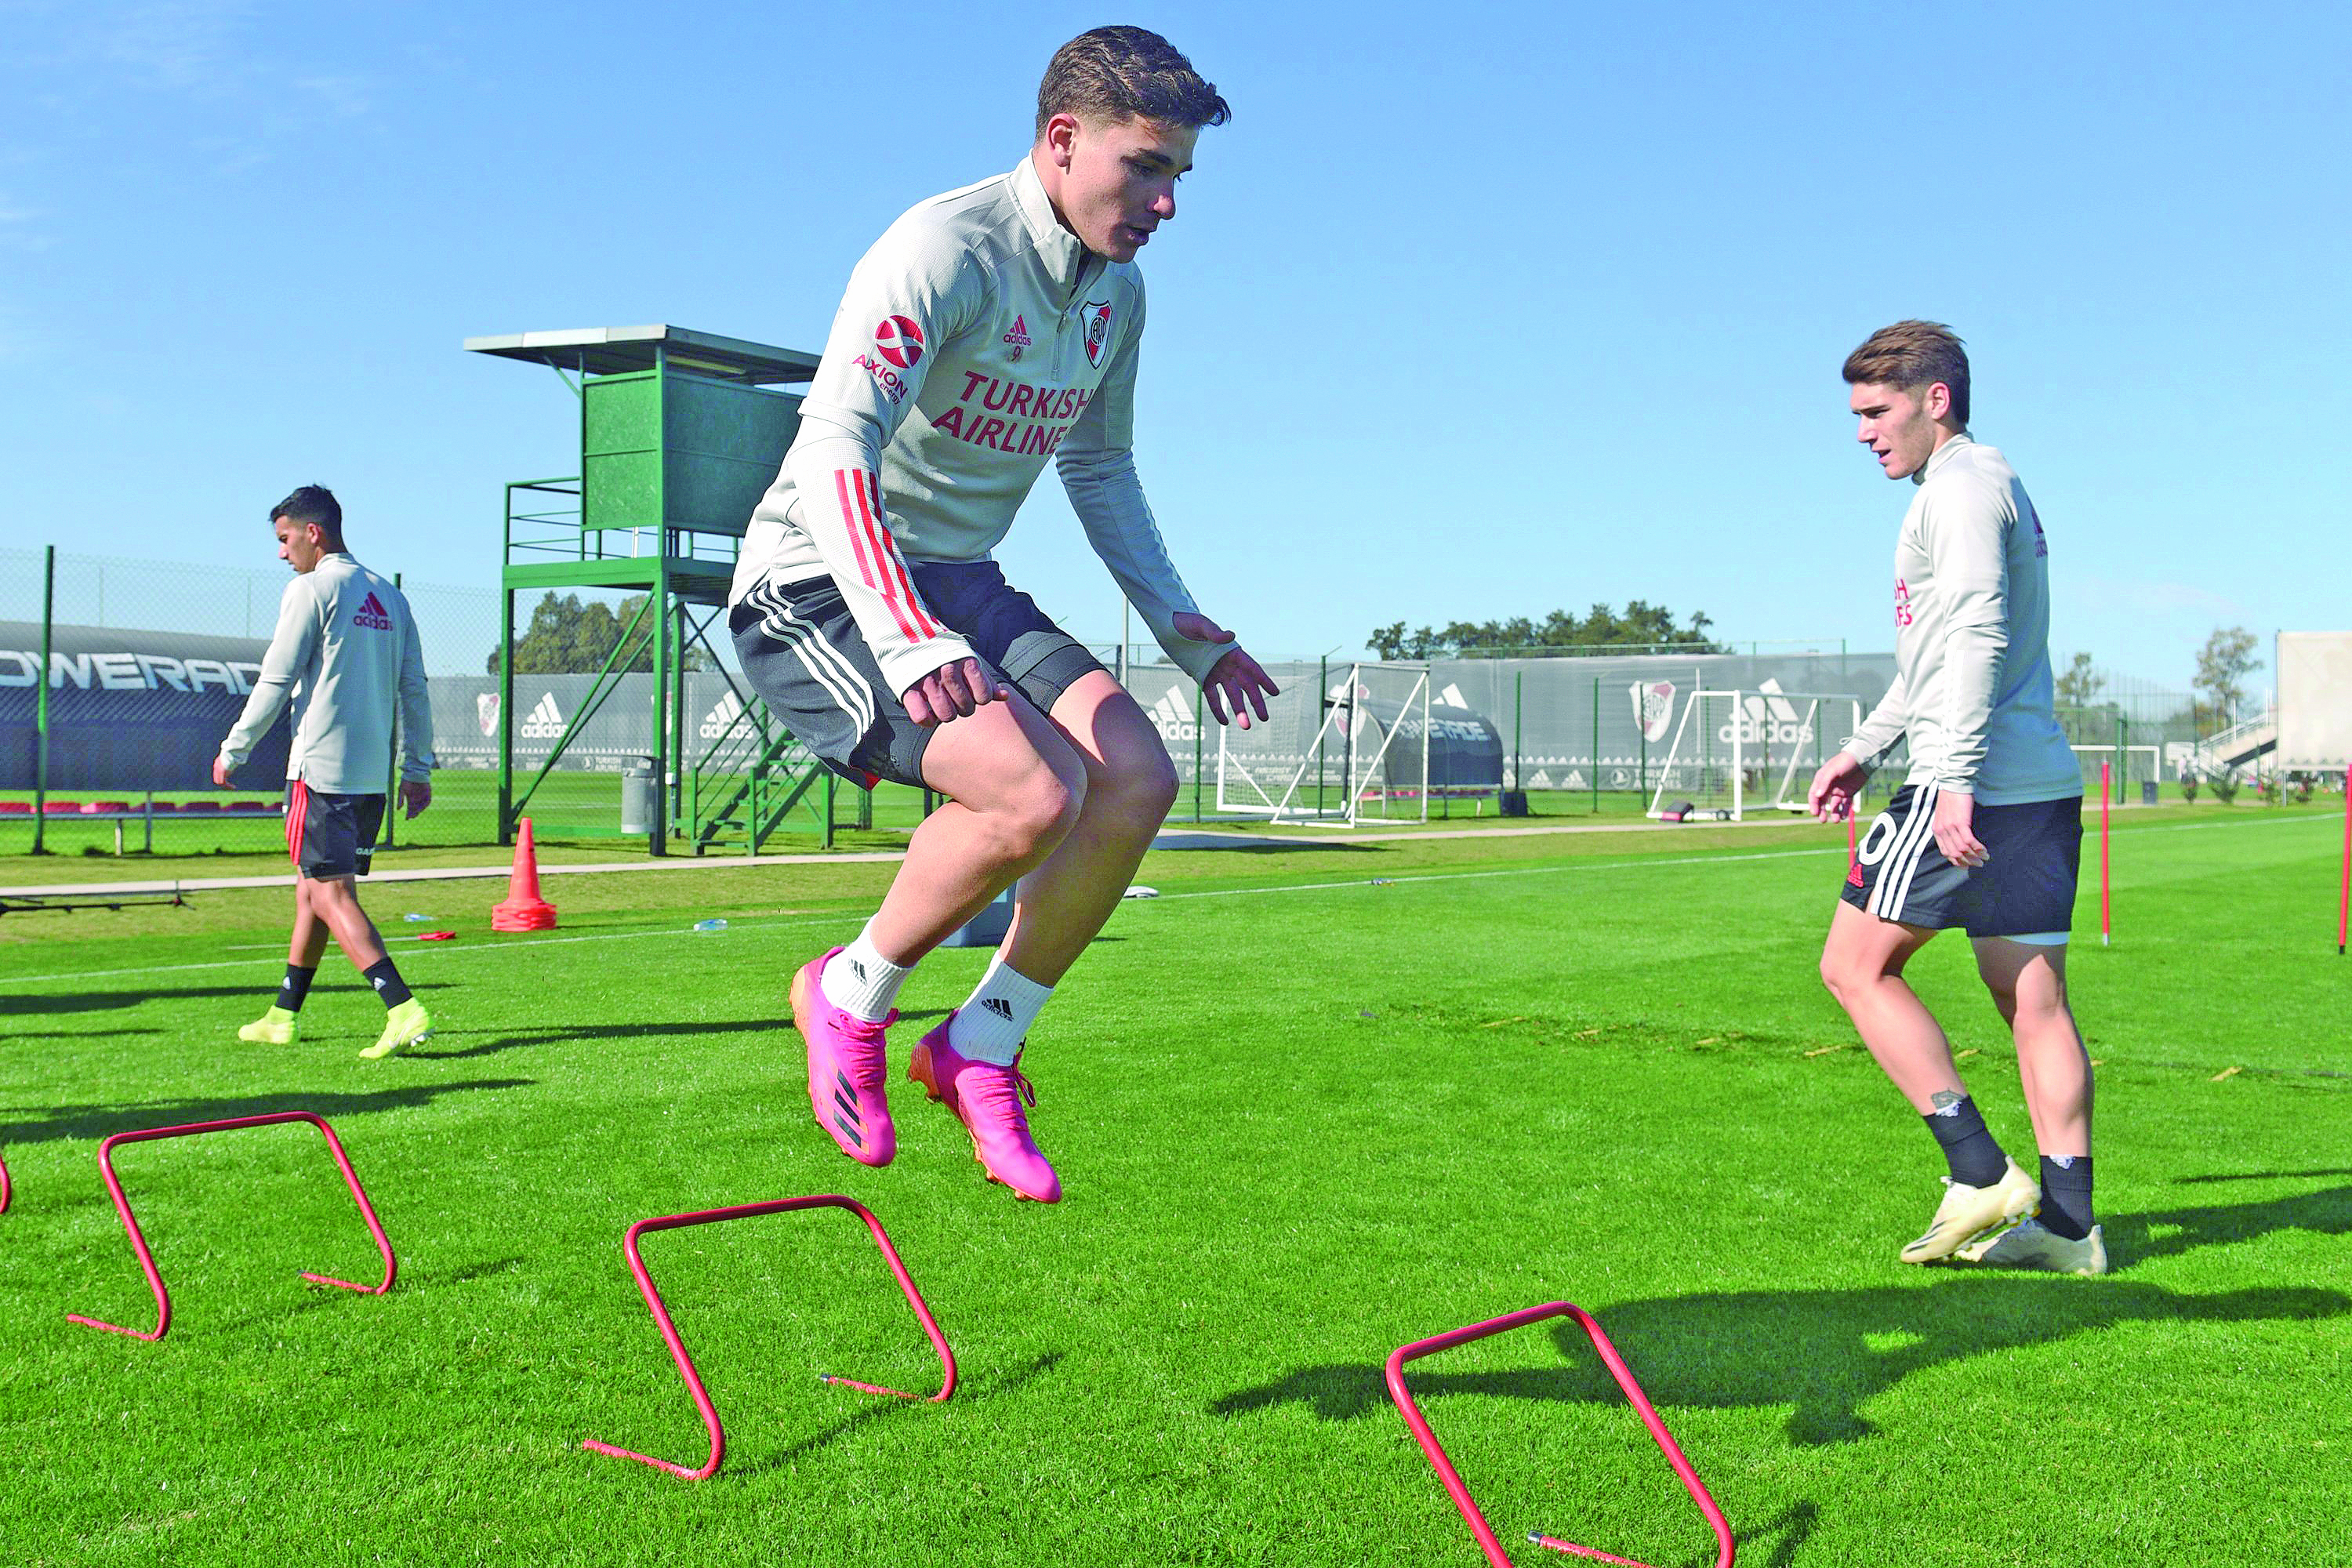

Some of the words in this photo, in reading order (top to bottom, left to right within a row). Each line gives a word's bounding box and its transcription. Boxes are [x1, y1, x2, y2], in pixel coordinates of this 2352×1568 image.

[1004, 332, 1031, 346] adidas
[852, 354, 908, 399] AXION
[879, 383, 901, 405] energy
[960, 370, 1094, 419] TURKISH
[1718, 720, 1814, 744] adidas
[982, 1000, 1014, 1022] adidas
